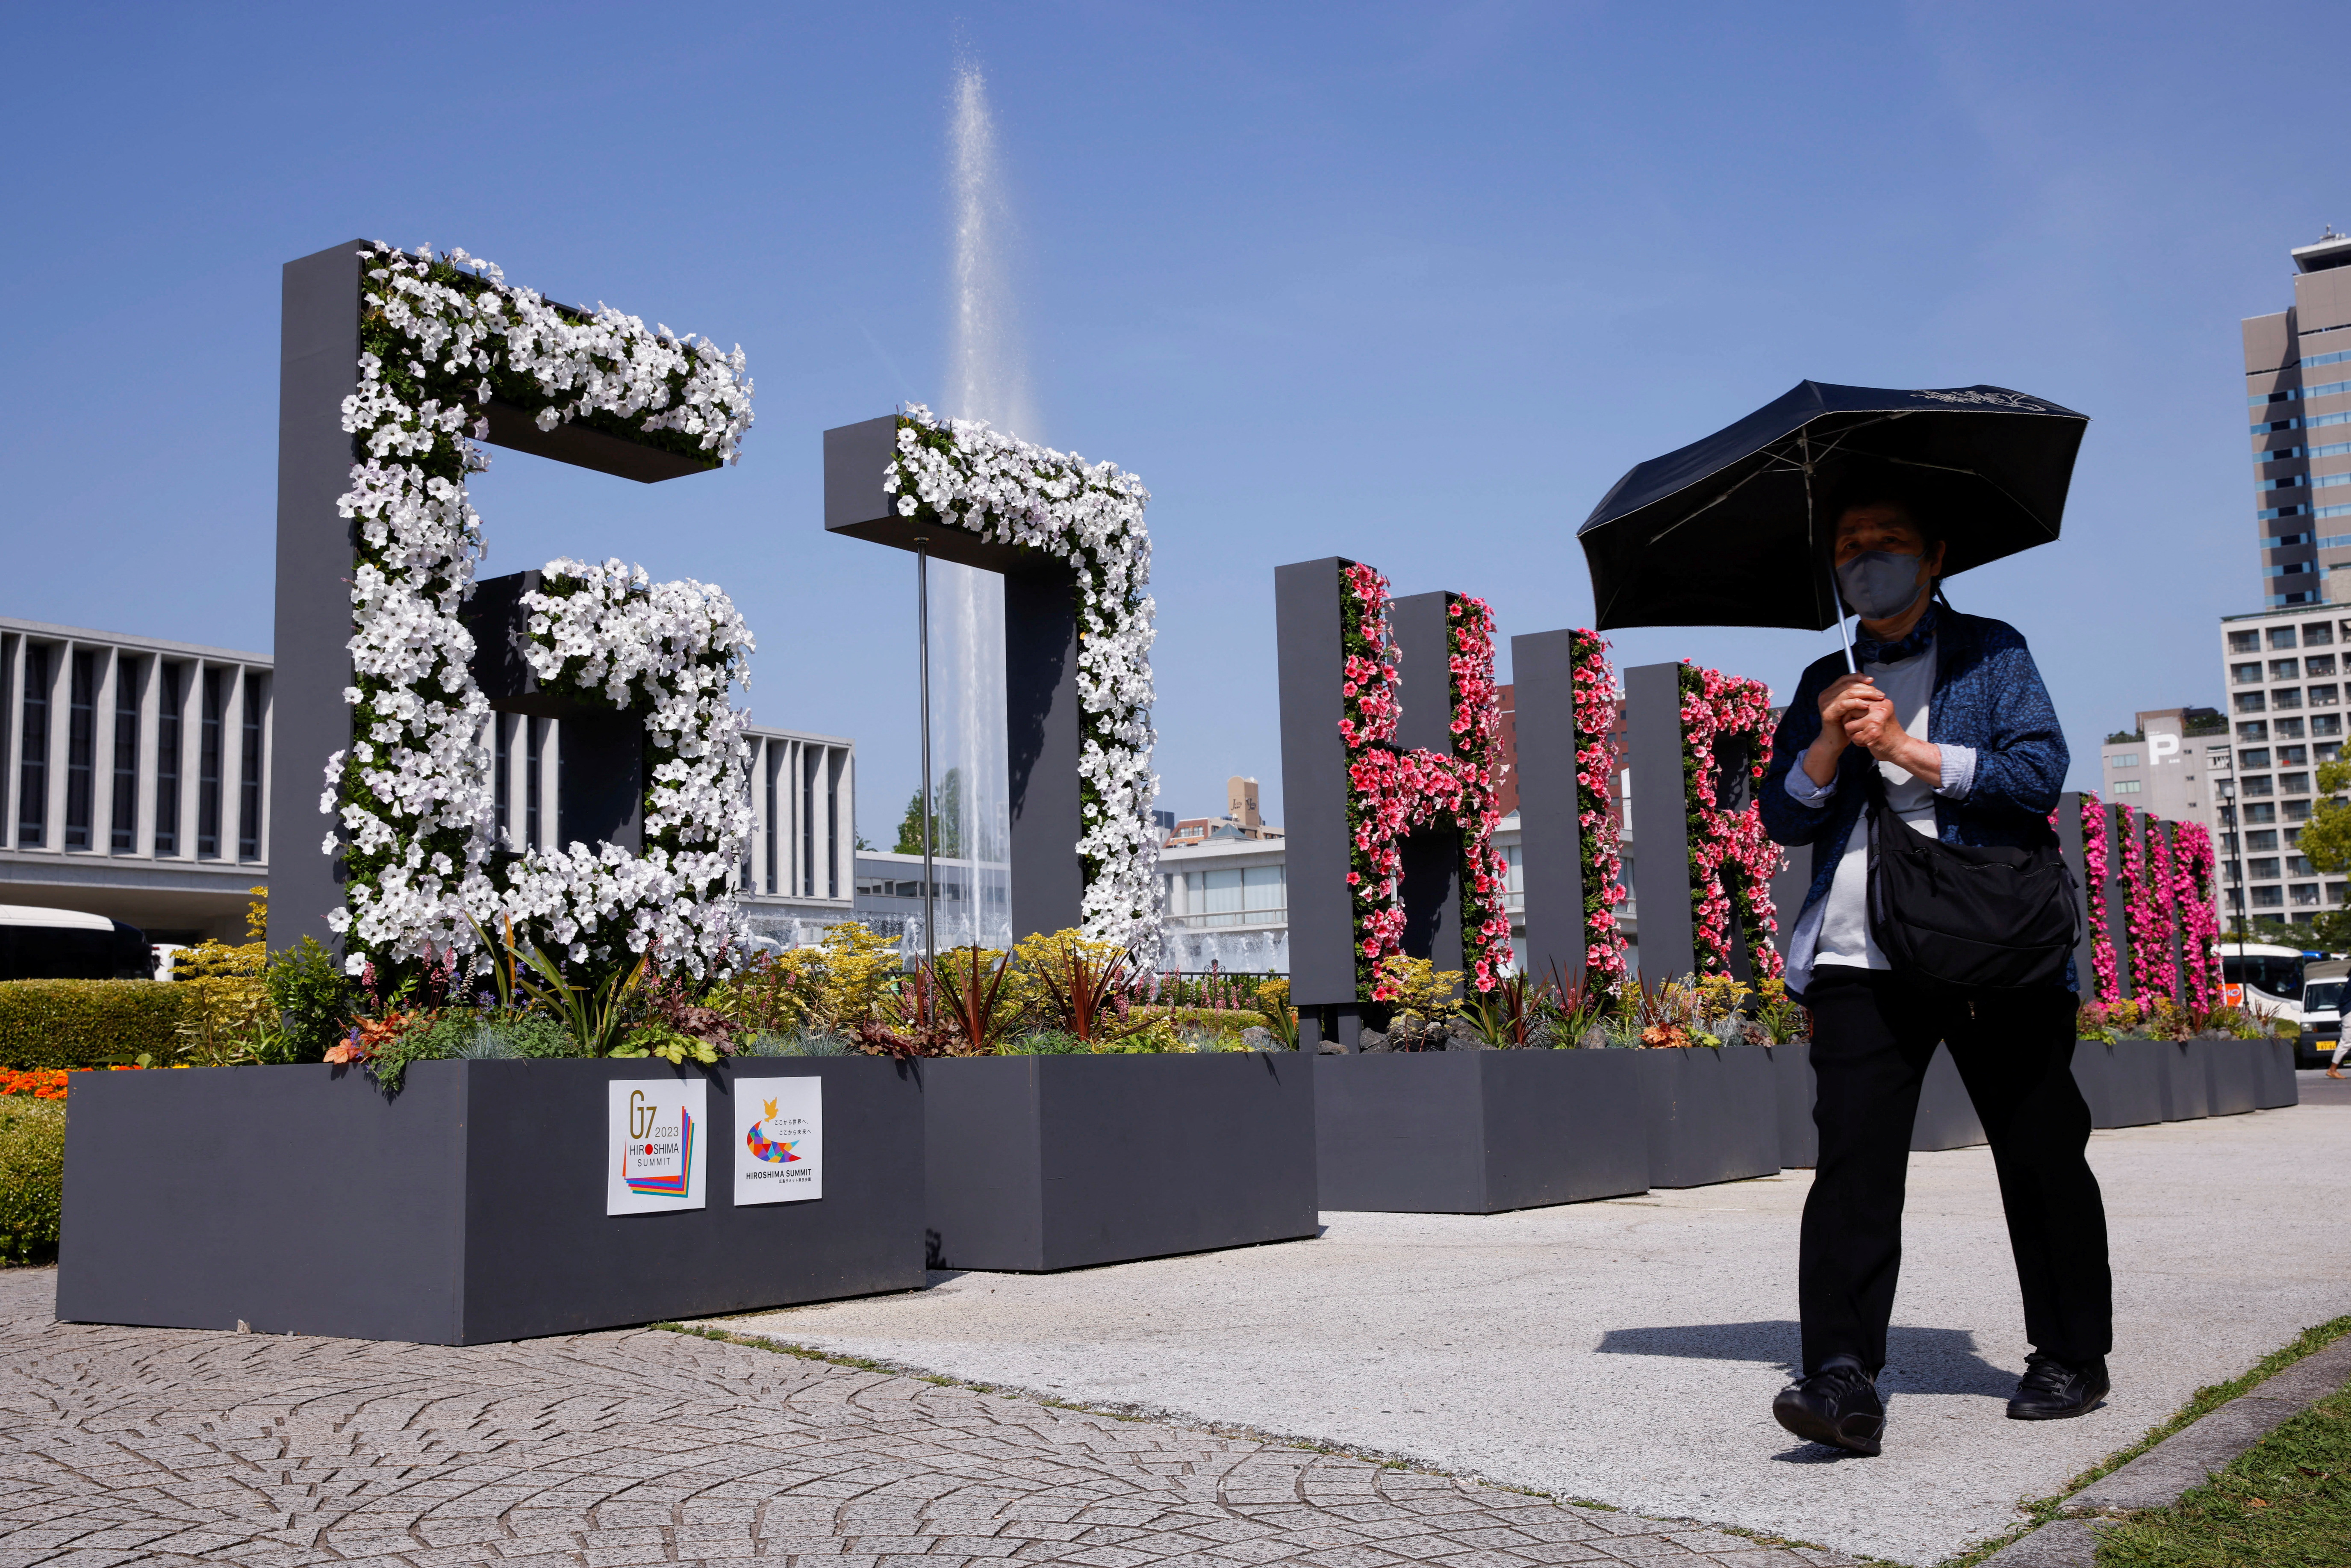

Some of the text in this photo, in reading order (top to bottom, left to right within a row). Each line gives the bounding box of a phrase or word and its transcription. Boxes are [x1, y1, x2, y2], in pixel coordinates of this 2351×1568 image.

[2148, 734, 2179, 765] P
[630, 1090, 679, 1140] G7 2023
[637, 1157, 671, 1167] SUMMIT
[746, 1168, 812, 1180] HIROSHIMA SUMMIT
